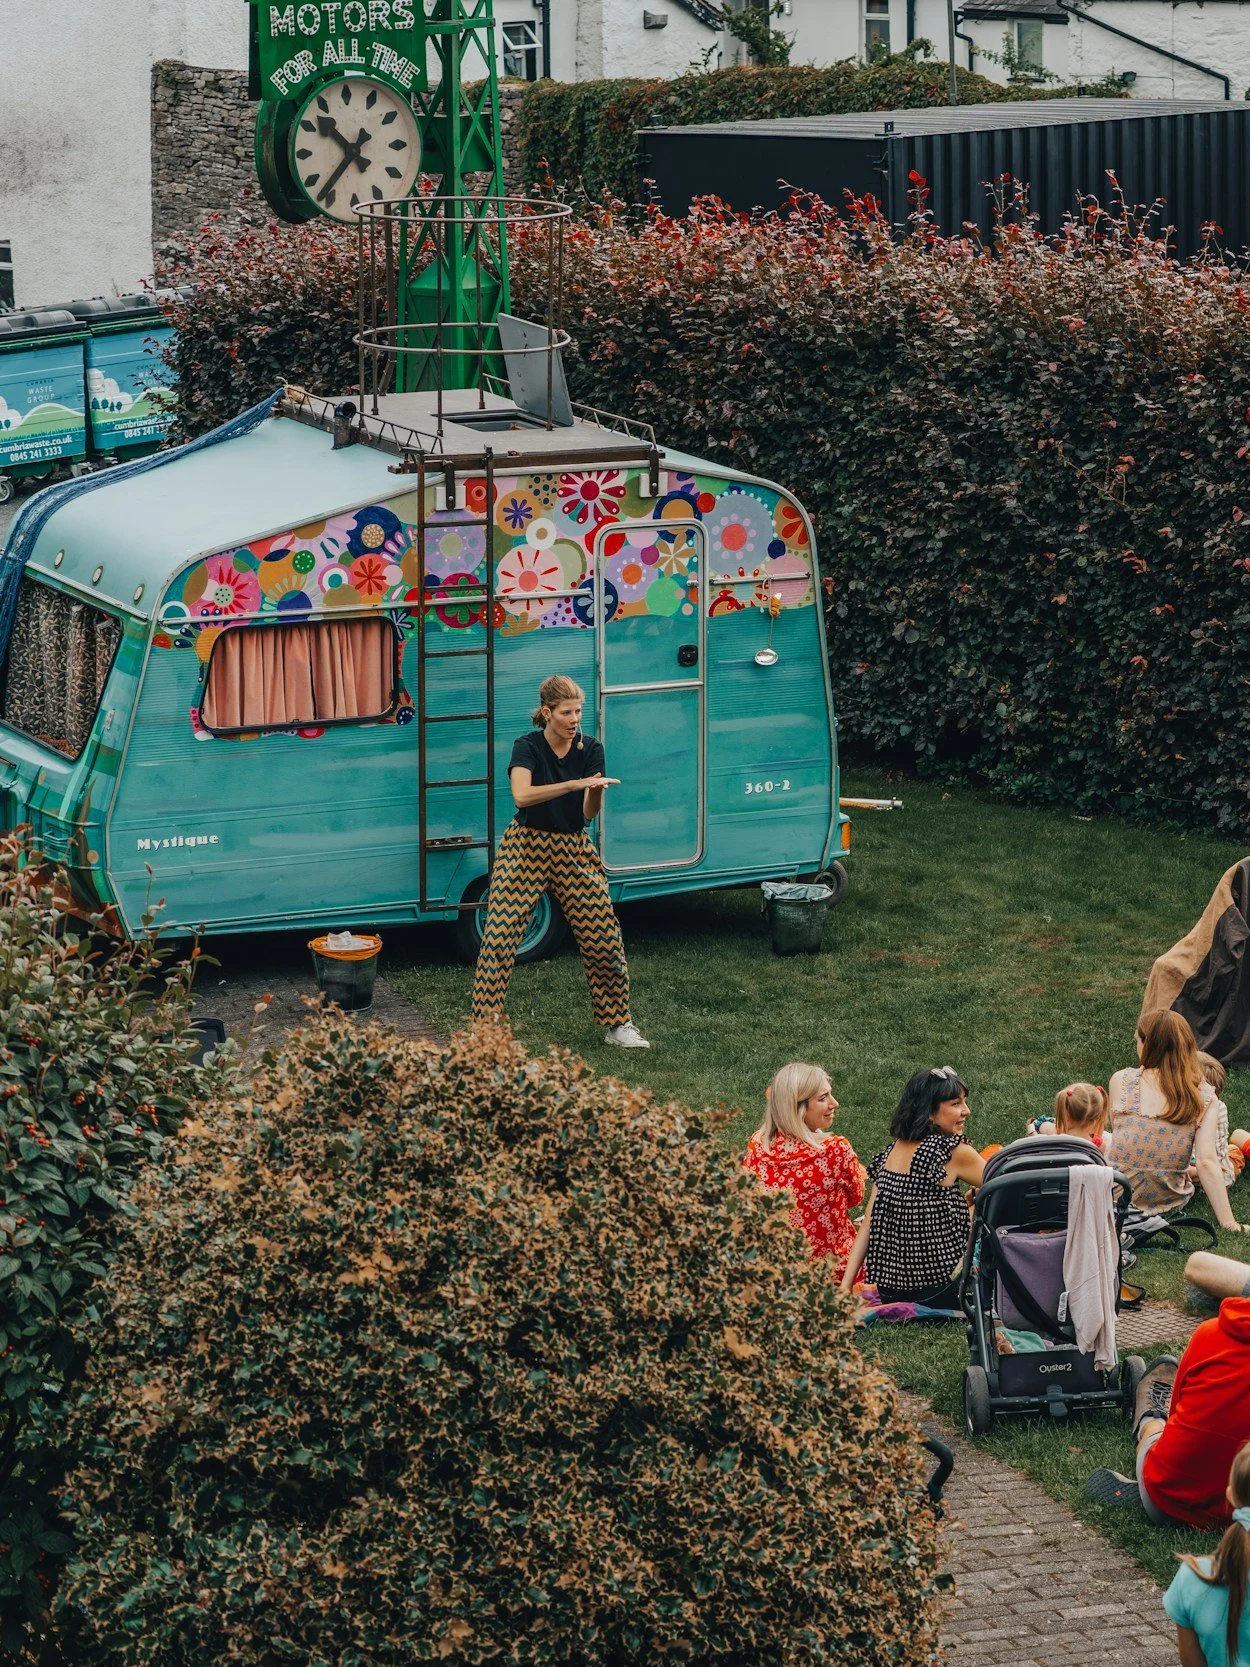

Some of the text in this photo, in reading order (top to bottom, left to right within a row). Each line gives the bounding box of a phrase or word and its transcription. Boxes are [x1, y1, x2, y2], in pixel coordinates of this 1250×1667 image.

[269, 0, 415, 37] MOTORS
[269, 38, 421, 96] FOR ALL TIME
[28, 385, 53, 395] WASTE
[27, 393, 55, 404] GROUP
[124, 428, 141, 438] 0845
[143, 426, 154, 435] 241
[0, 435, 73, 454] cumbriawaste.co.uk
[10, 446, 62, 462] 0845 241 3333
[745, 780, 791, 794] 360-2
[137, 834, 219, 851] Mystique
[1039, 1362, 1073, 1373] Oyster2
